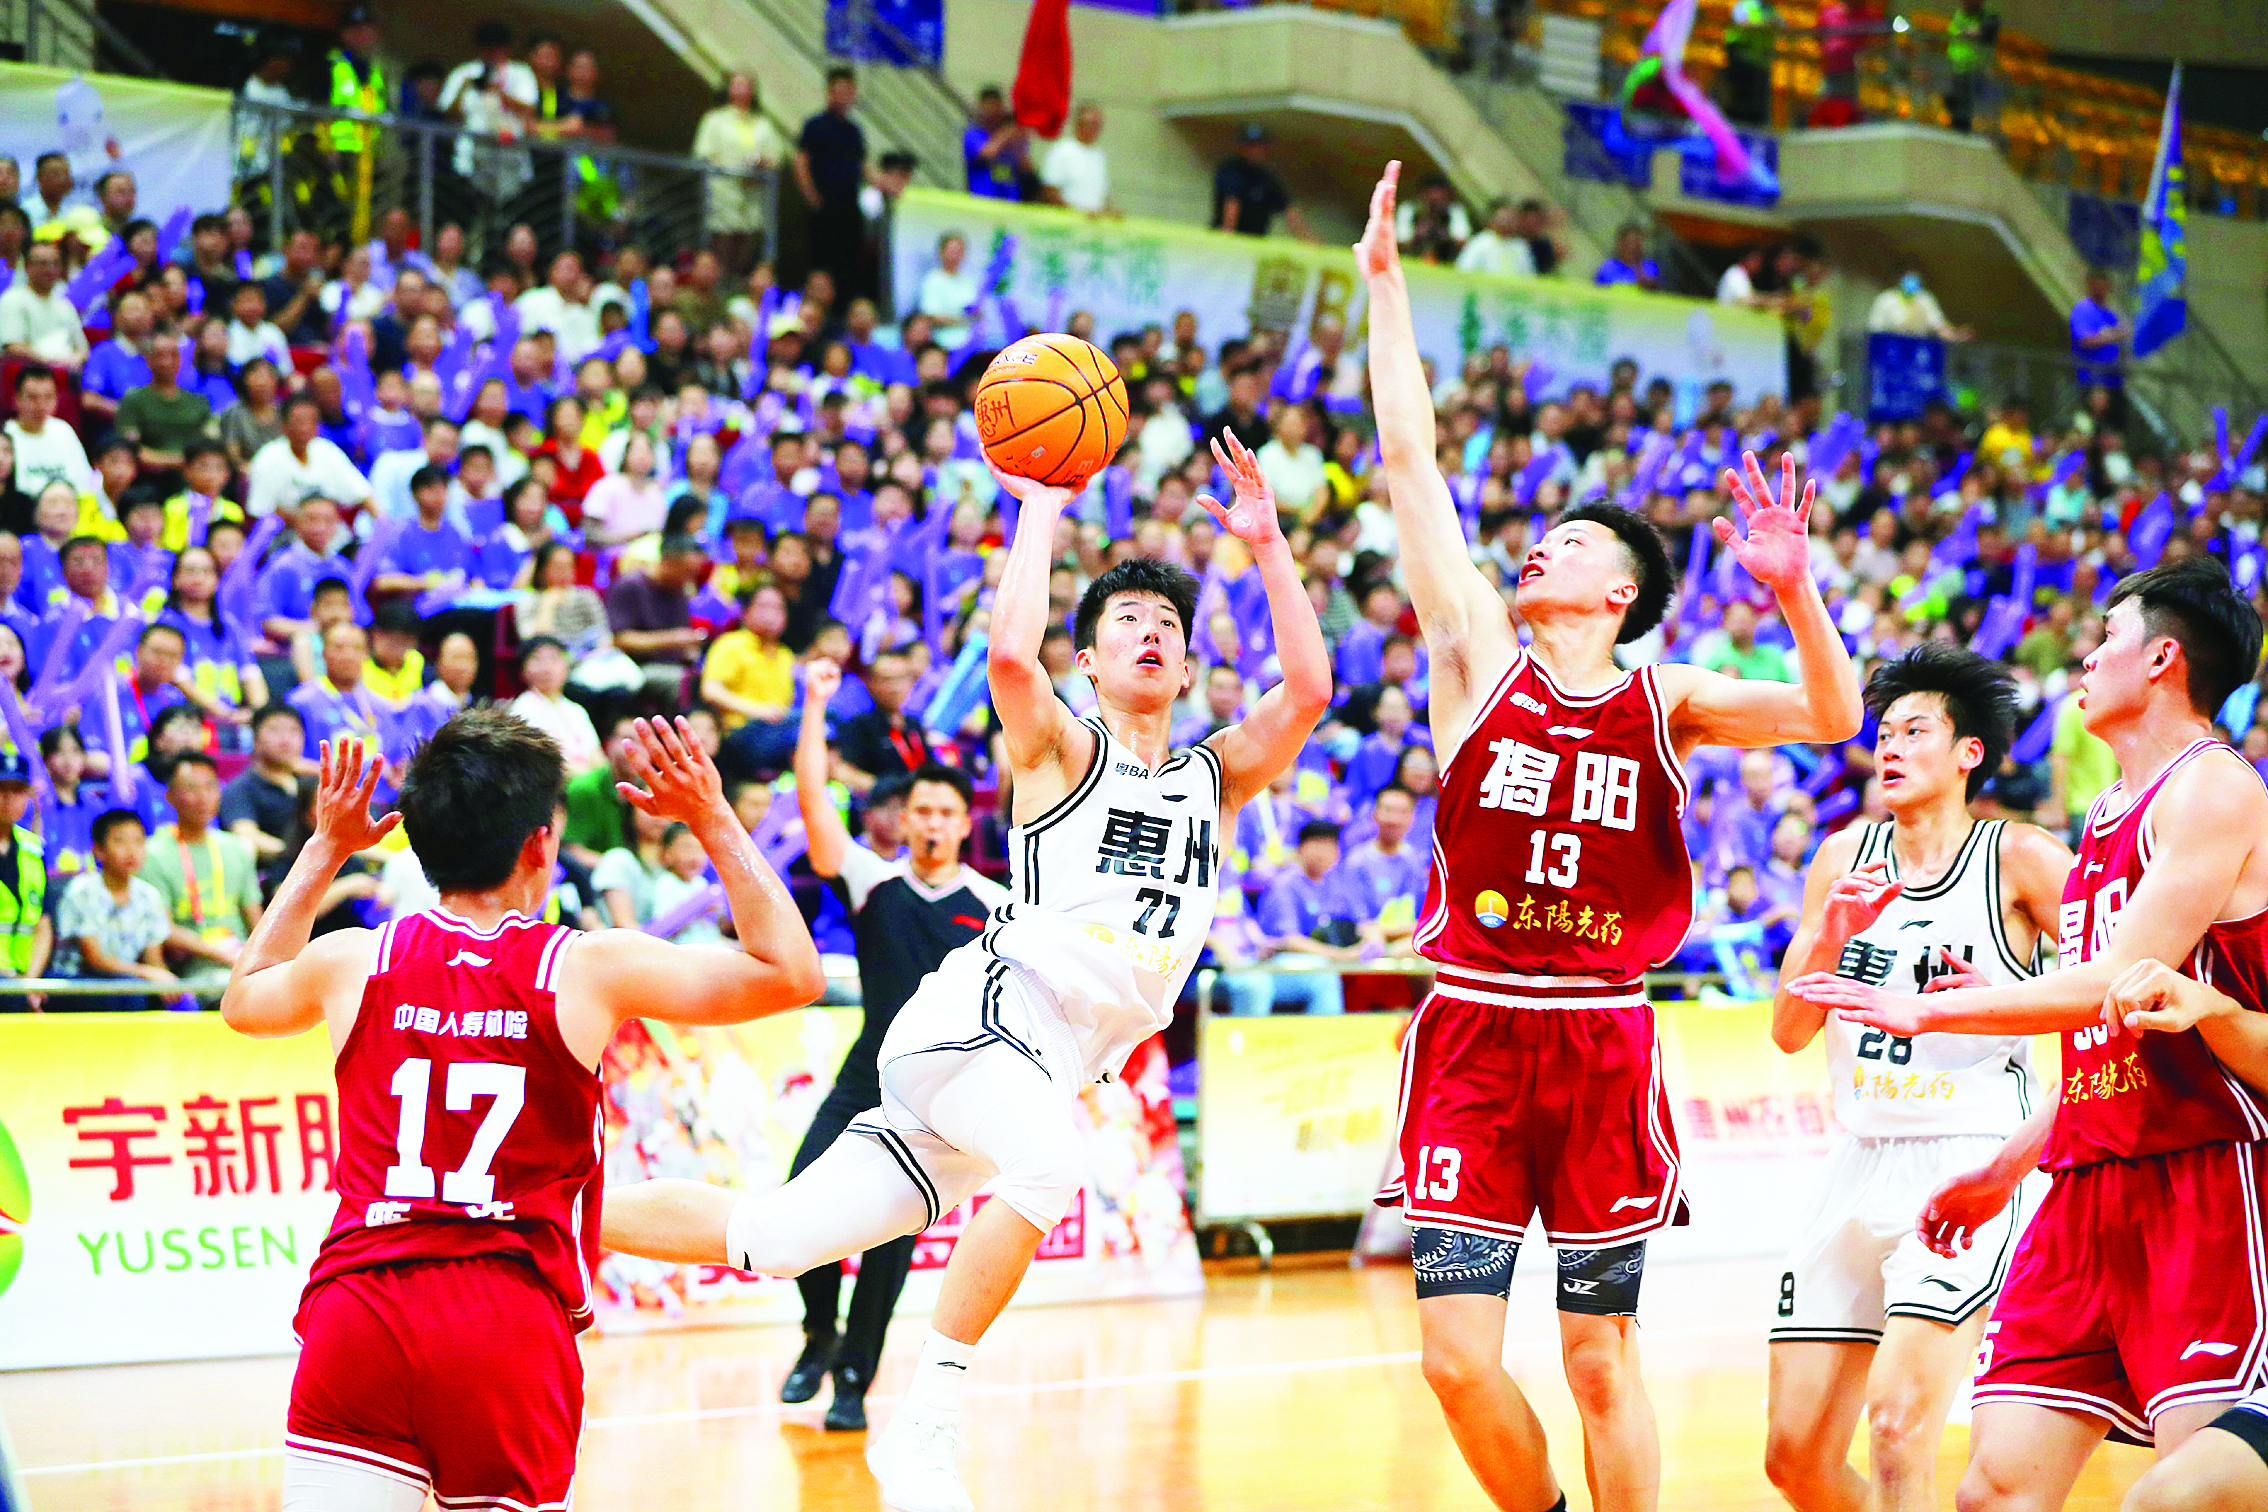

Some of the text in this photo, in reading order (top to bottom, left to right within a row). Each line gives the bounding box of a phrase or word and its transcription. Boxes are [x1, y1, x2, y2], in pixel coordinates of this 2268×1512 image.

[1115, 762, 1149, 779] 粤BA
[1479, 737, 1640, 831] 揭阳
[1096, 808, 1218, 887] 惠州
[1525, 830, 1581, 889] 13
[1132, 888, 1181, 938] 77
[393, 1003, 529, 1039] 中国人寿财险
[384, 1057, 527, 1205] 17
[1415, 1145, 1462, 1201] 13
[77, 1226, 297, 1275] YUSSEN
[1563, 1277, 1600, 1296] JZ
